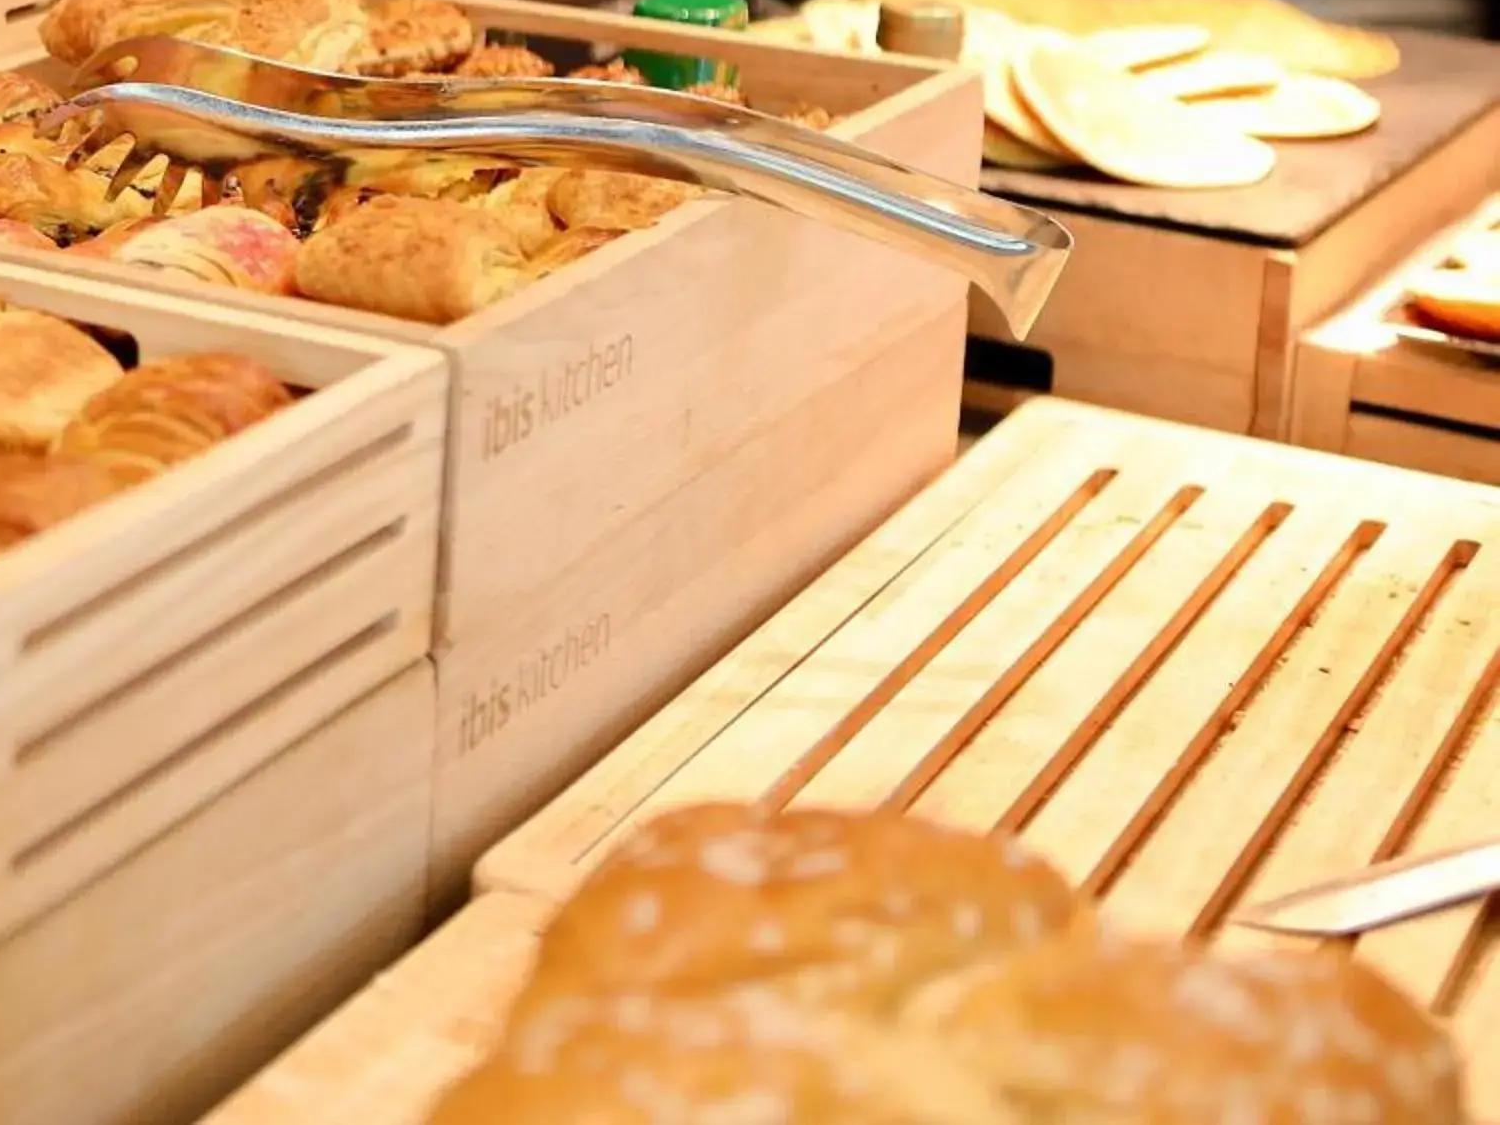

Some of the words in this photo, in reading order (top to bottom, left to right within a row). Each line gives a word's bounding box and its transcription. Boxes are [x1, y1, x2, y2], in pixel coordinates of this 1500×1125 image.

[481, 383, 535, 463] ibis
[539, 332, 633, 428] kitchen
[457, 677, 511, 758] ibis
[516, 611, 611, 716] kitchen
